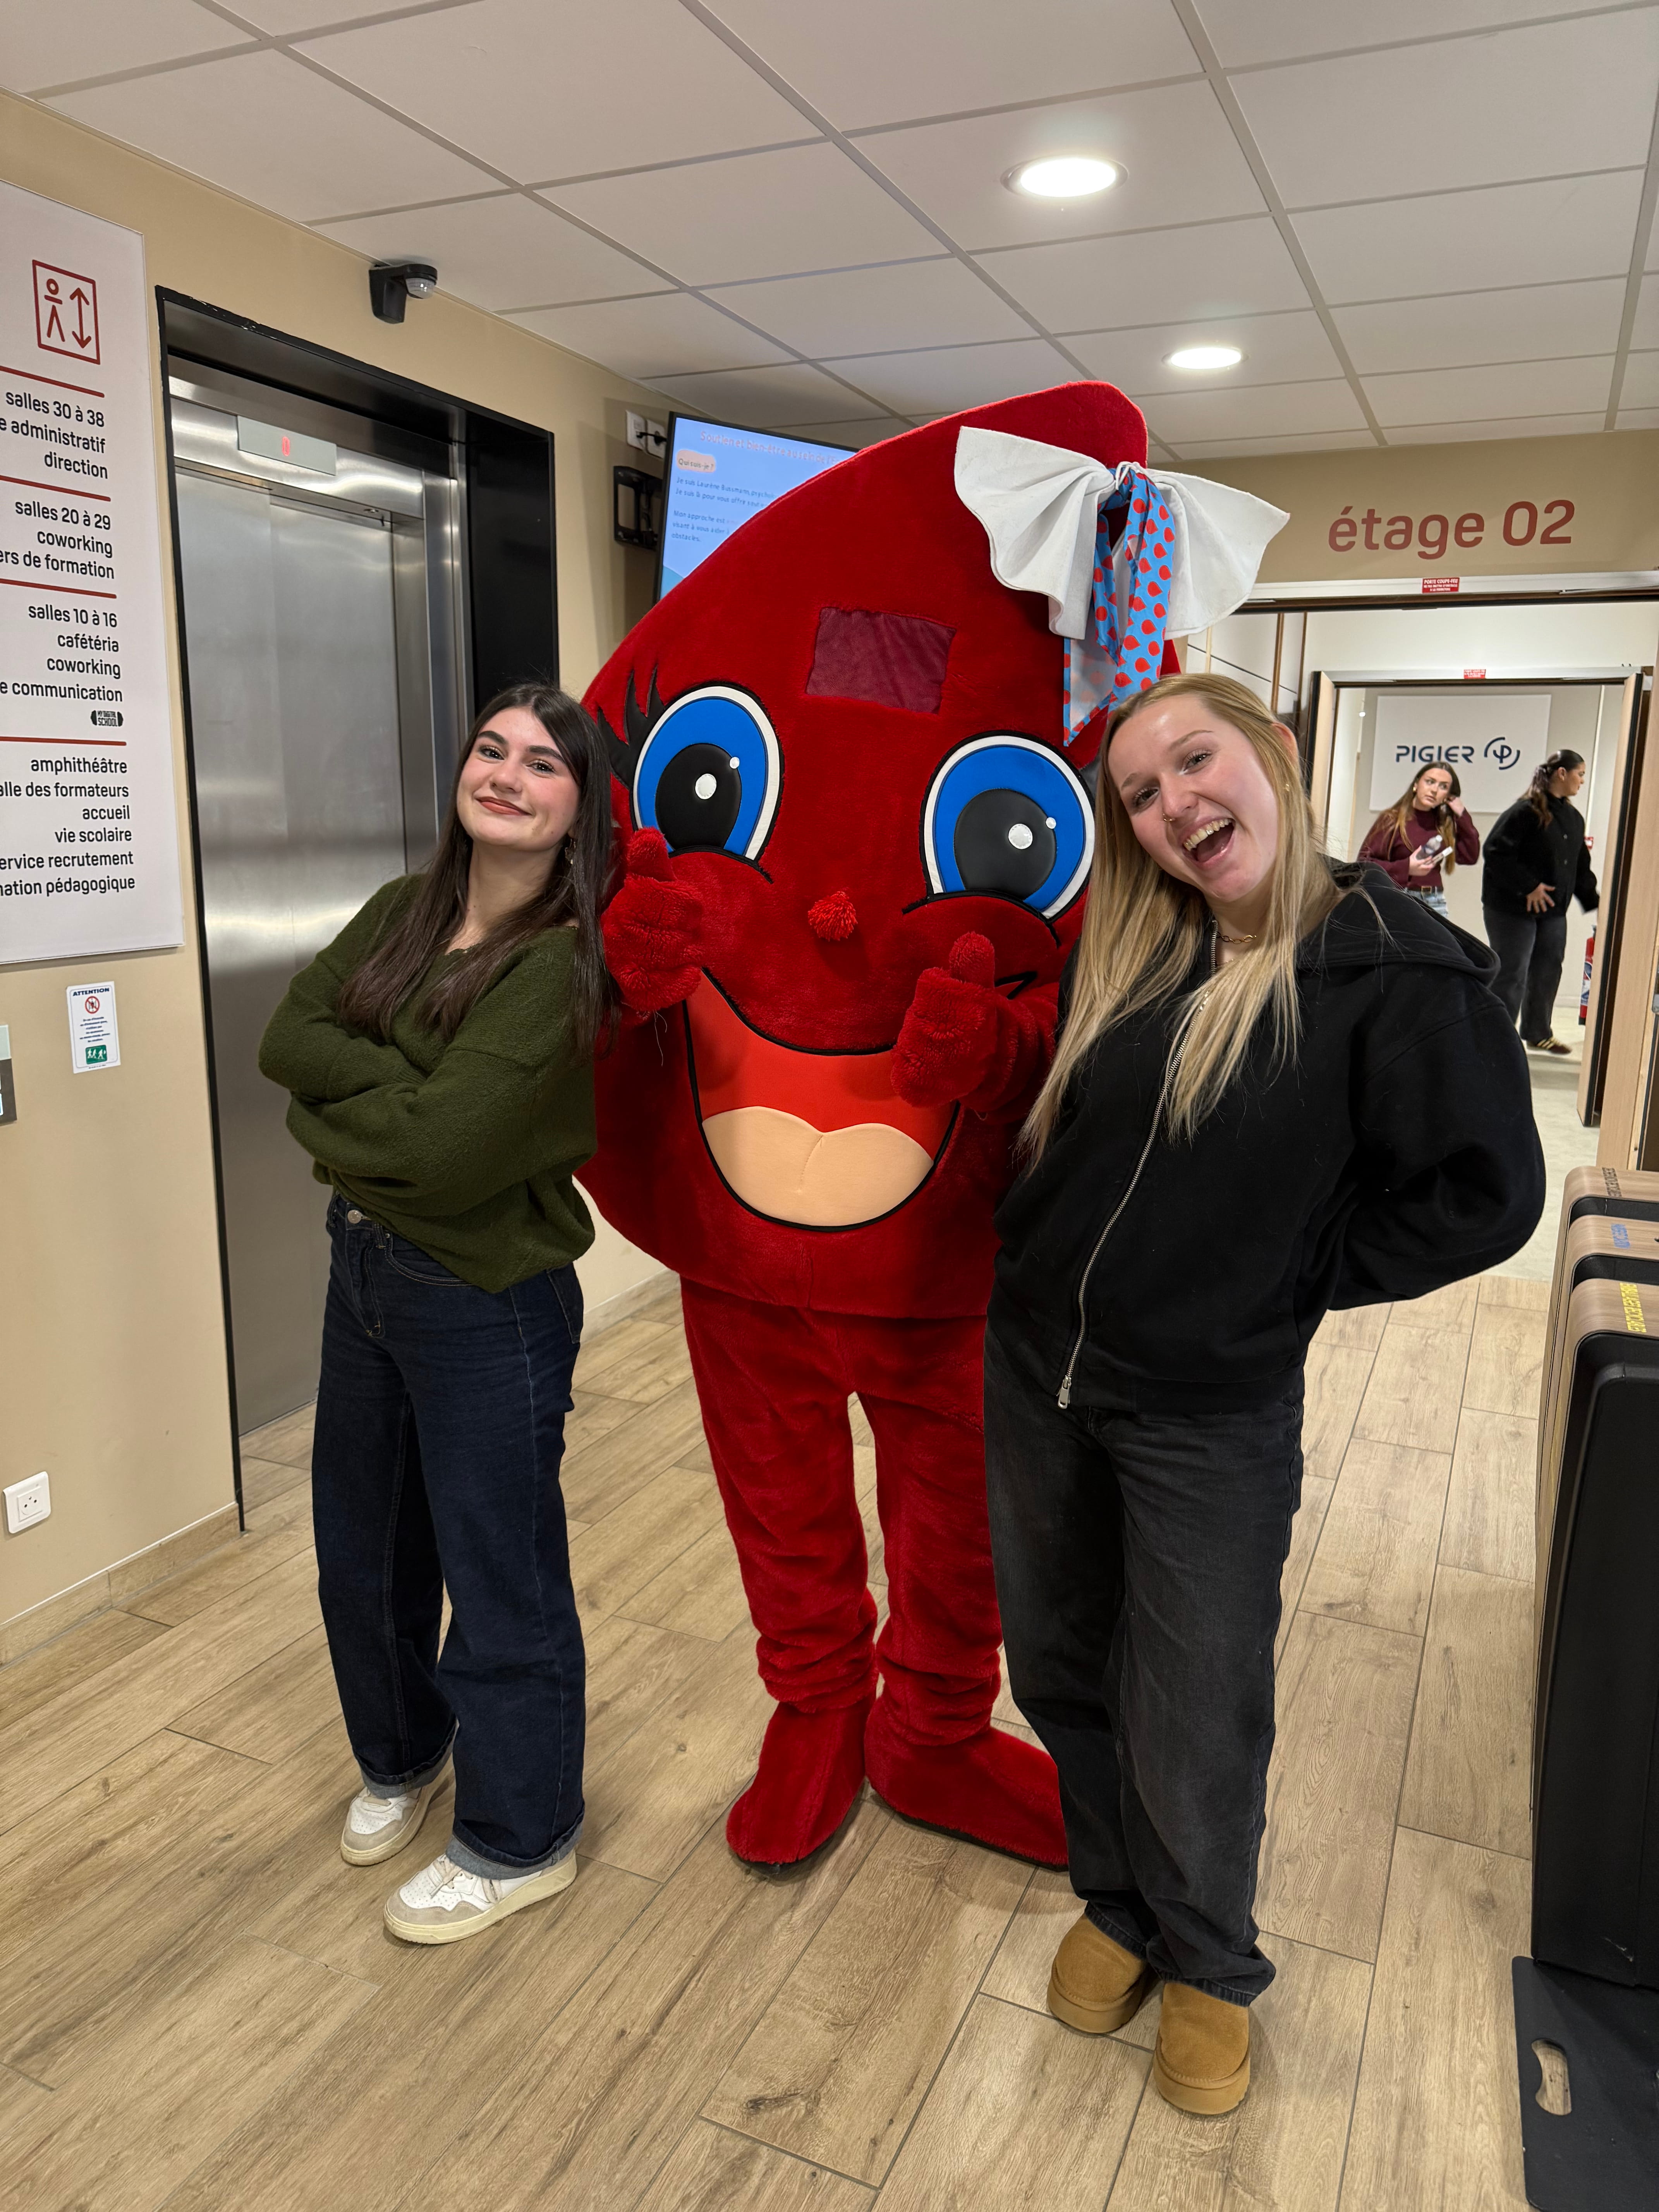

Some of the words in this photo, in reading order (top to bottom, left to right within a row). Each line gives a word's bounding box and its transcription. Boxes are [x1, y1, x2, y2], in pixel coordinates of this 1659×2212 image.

[6, 392, 50, 414] salles
[53, 401, 71, 419] 30
[75, 405, 83, 422] à
[87, 409, 104, 427] 38
[11, 420, 105, 453] administratif
[282, 436, 290, 456] 0
[44, 451, 108, 479] direction
[15, 501, 58, 521] salles
[61, 507, 79, 524] 20
[83, 510, 91, 527] à
[94, 514, 110, 530] 29
[1328, 505, 1485, 560] étage
[1502, 500, 1575, 546] 02
[37, 531, 112, 558] coworking
[23, 551, 41, 568] de
[45, 554, 114, 579] formation
[29, 604, 70, 622] salles
[73, 608, 88, 624] 10
[92, 610, 100, 625] à
[103, 612, 117, 627] 16
[58, 633, 119, 652] cafétéria
[47, 658, 120, 679] coworking
[12, 683, 122, 702] communication
[98, 717, 117, 727] SCHOOL
[1396, 745, 1474, 763] PIGIER
[31, 757, 127, 775] amphithéâtre
[26, 782, 51, 797] des
[54, 782, 129, 797] formateurs
[82, 805, 130, 820] accueil
[55, 828, 76, 843] vie
[79, 827, 132, 842] scolaire
[48, 851, 134, 868] recrutement
[46, 875, 135, 897] pédagogique
[73, 988, 110, 996] ATTENTION
